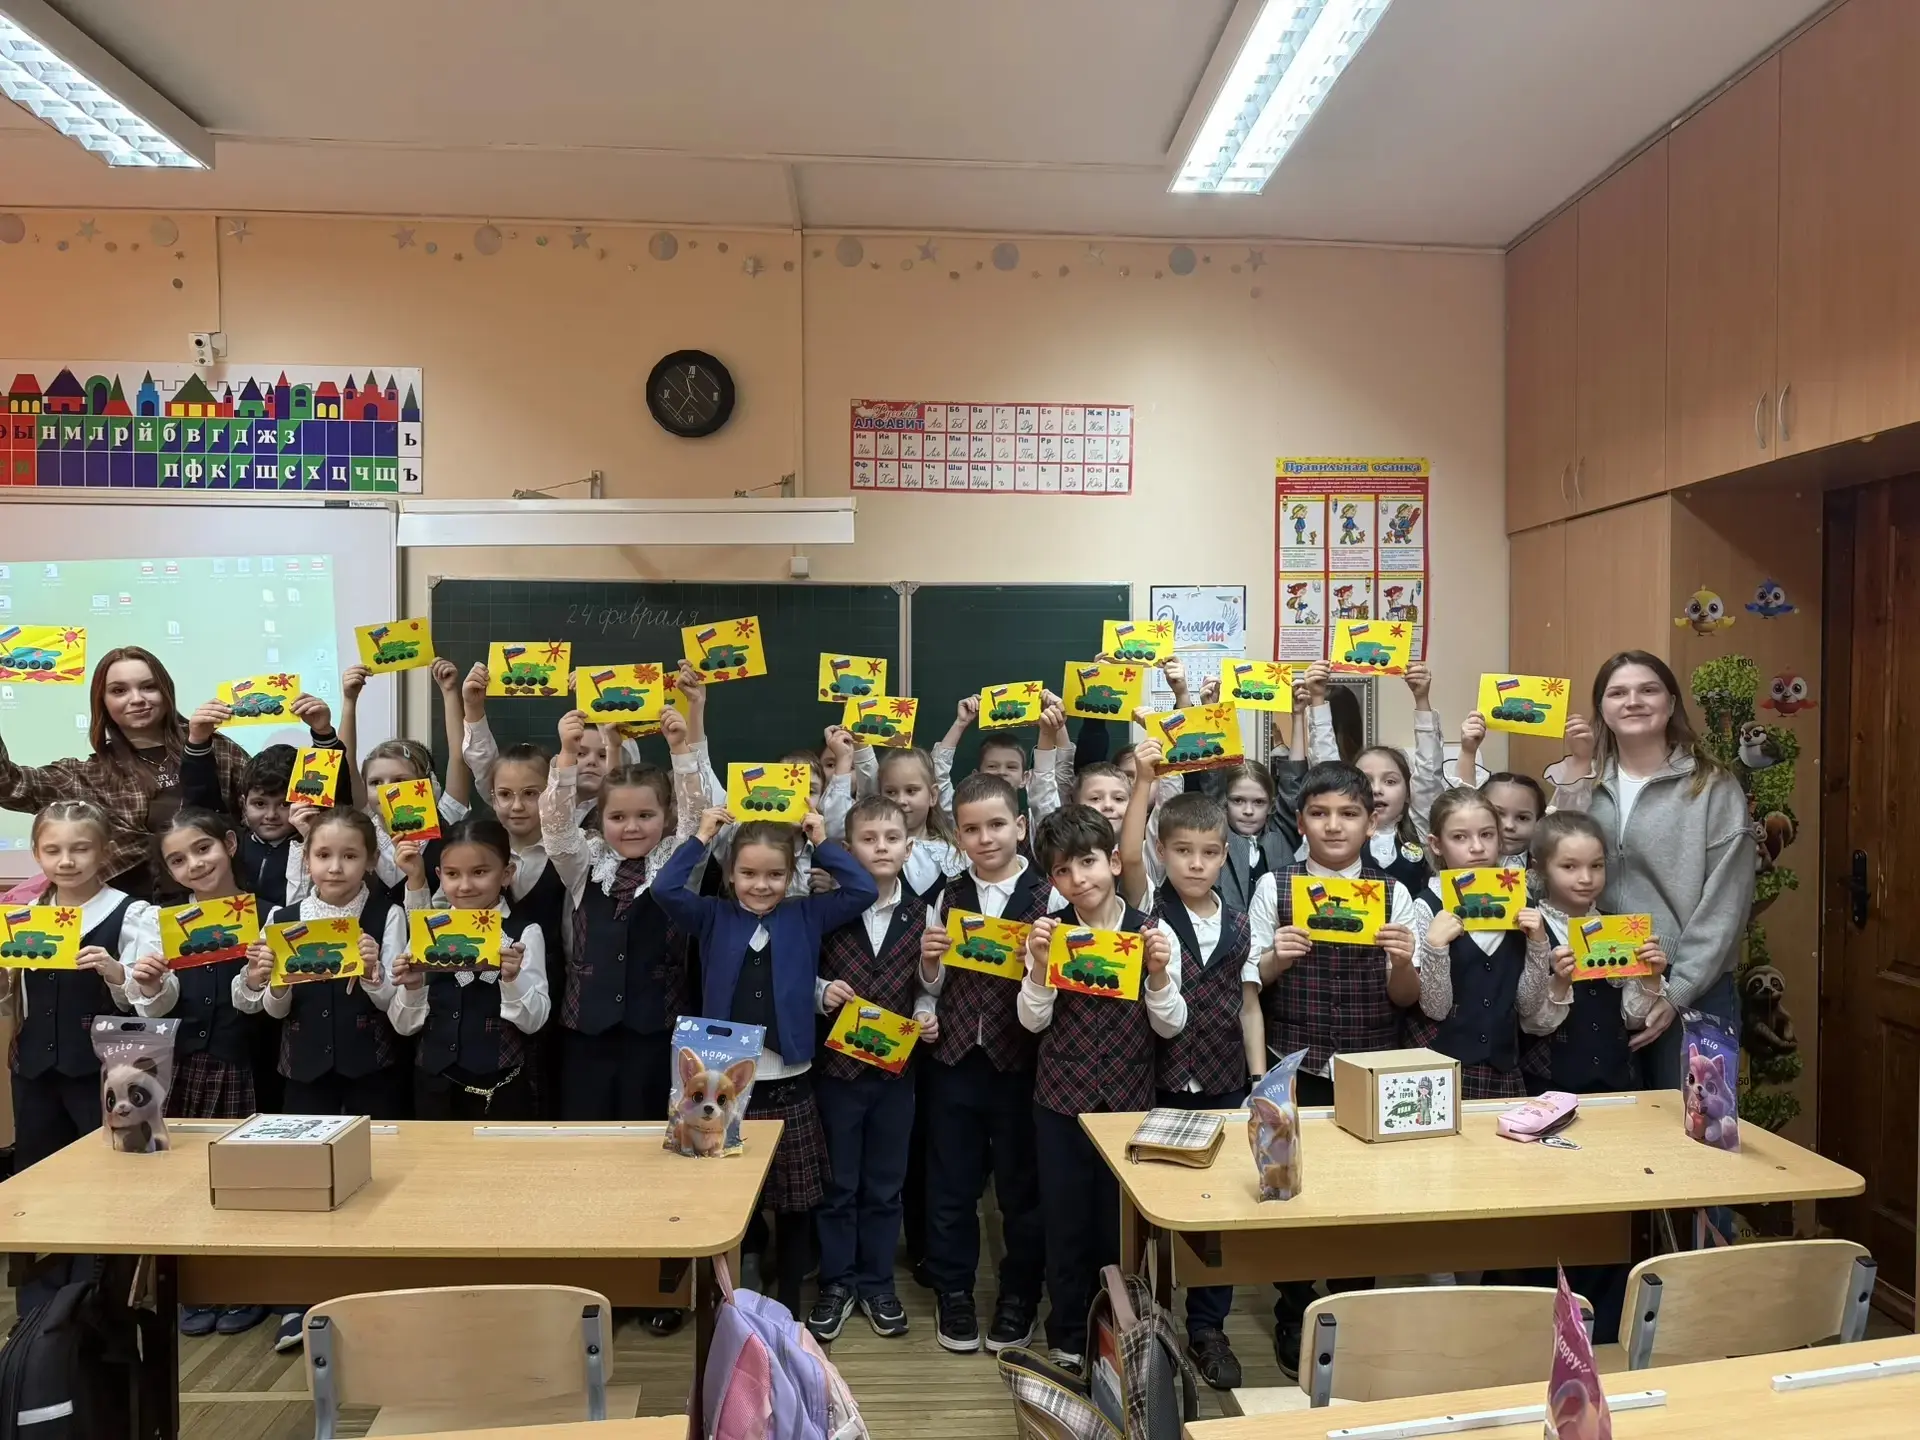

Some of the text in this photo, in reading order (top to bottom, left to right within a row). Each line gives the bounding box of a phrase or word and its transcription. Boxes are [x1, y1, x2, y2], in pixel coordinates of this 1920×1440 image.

[854, 417, 926, 431] АЛФАВИТ
[42, 426, 57, 440] н
[64, 426, 82, 440] м
[89, 426, 104, 441] л
[114, 427, 129, 447] р
[138, 422, 153, 442] й
[163, 423, 176, 442] б
[187, 428, 201, 442] в
[212, 429, 224, 442] г
[234, 429, 248, 446] д
[257, 430, 277, 443] ж
[284, 430, 295, 444] з
[164, 463, 179, 477] п
[185, 458, 203, 483] ф
[211, 464, 226, 478] к
[236, 464, 249, 478] т
[256, 466, 278, 479] ш
[284, 466, 296, 480] с
[307, 466, 320, 480] х
[332, 466, 347, 483] ц
[355, 467, 369, 480] ч
[375, 467, 397, 484] щ
[1284, 461, 1422, 474] Правильная осанка
[566, 596, 700, 639] 24 февраля
[1175, 633, 1225, 642] ОССИИ
